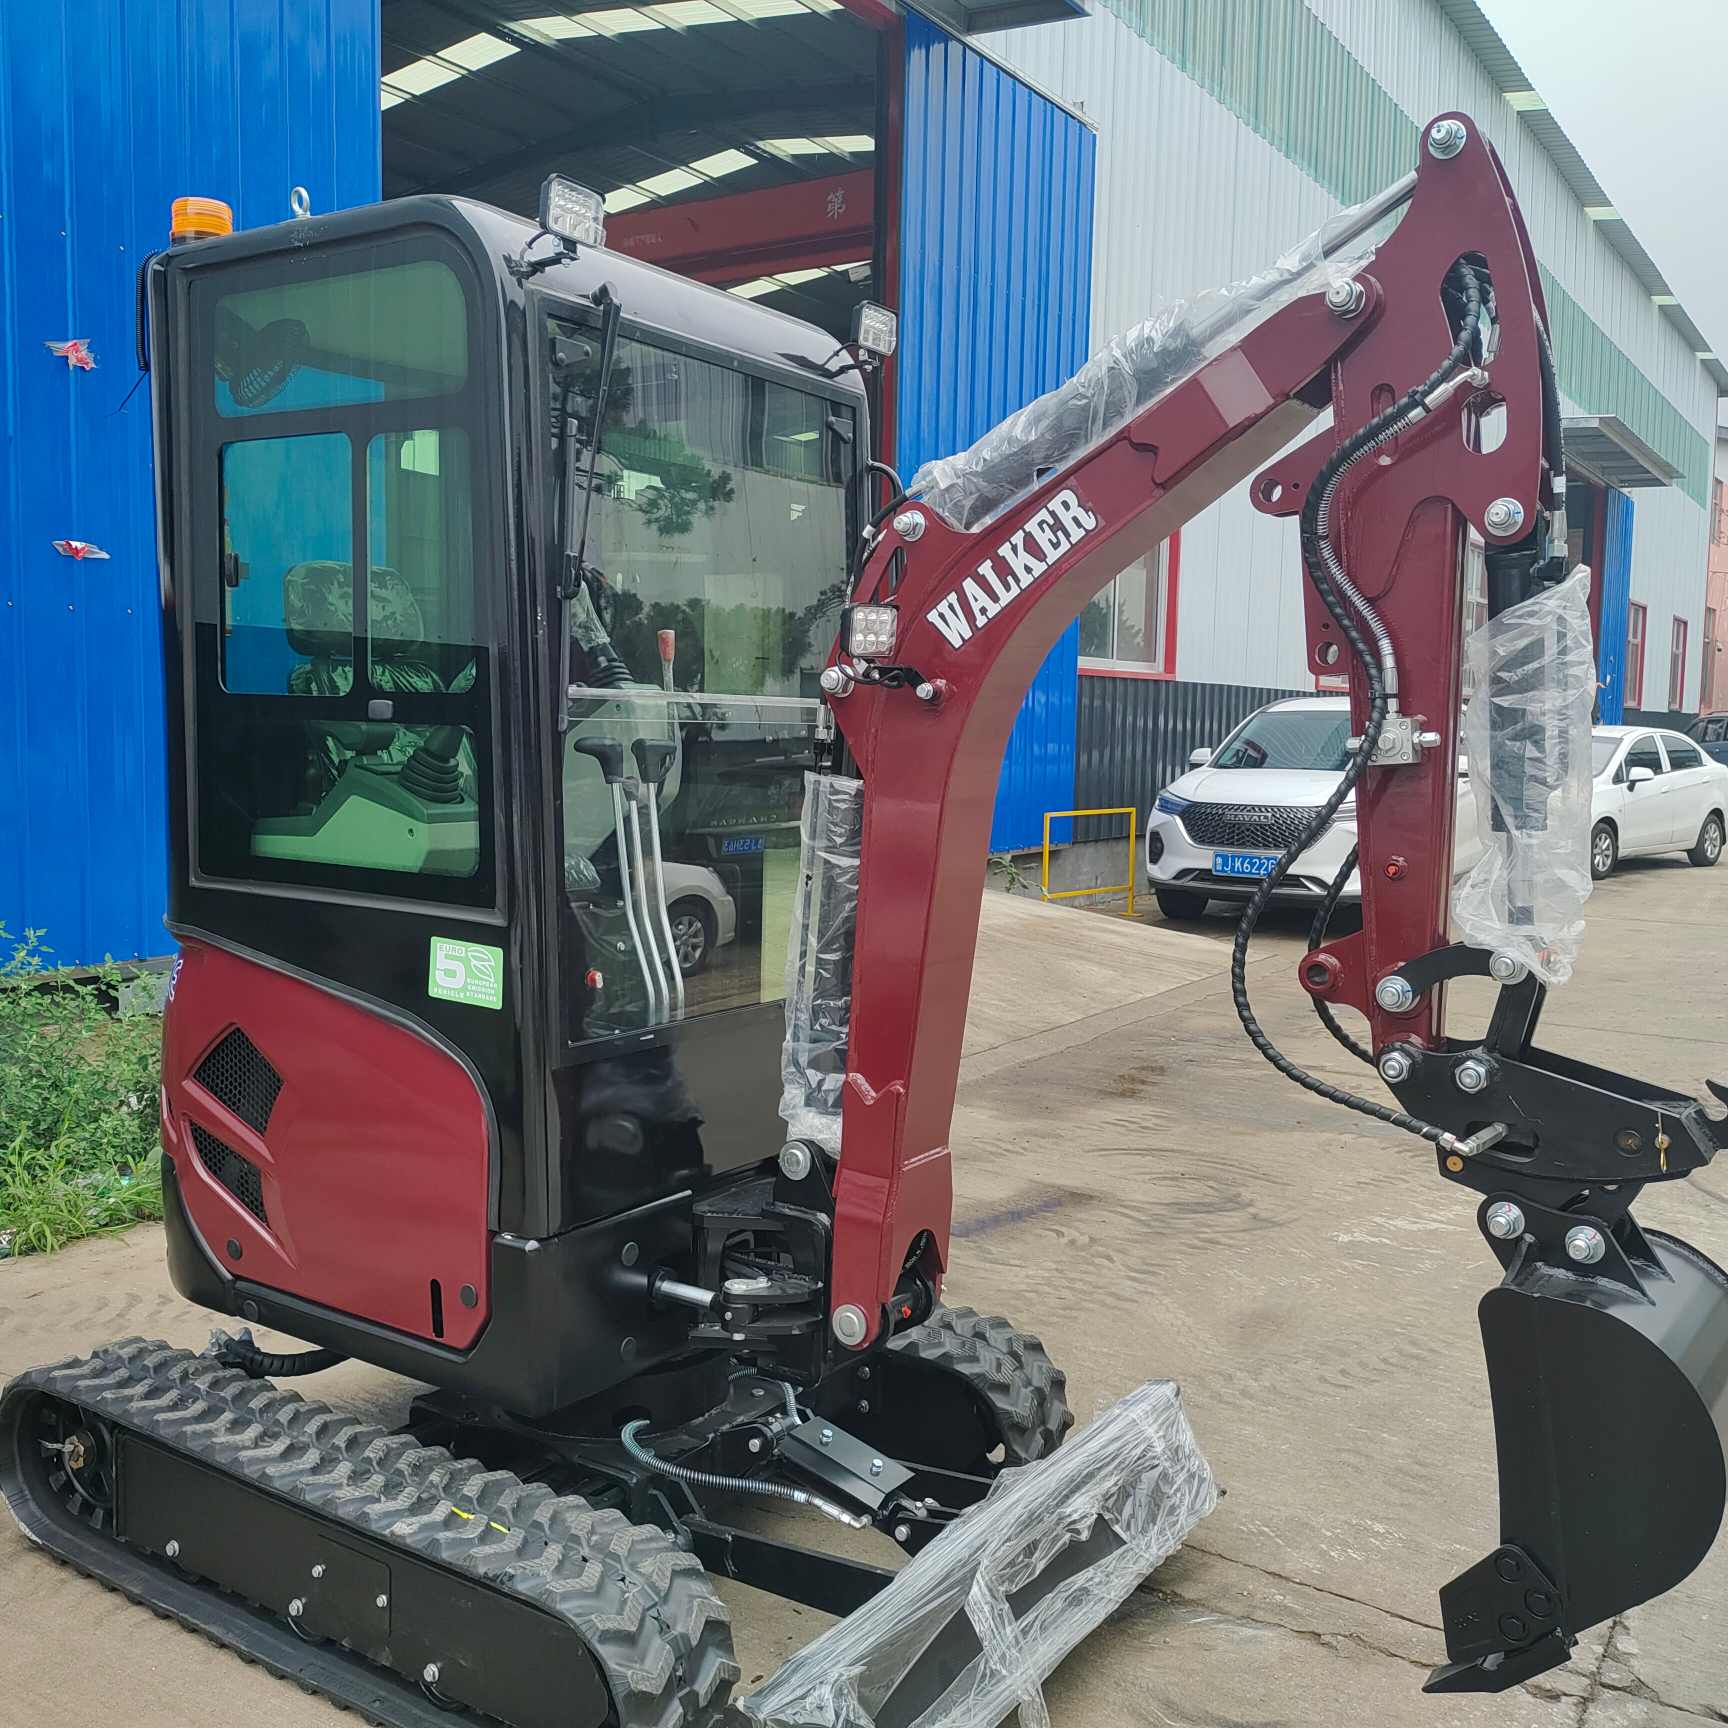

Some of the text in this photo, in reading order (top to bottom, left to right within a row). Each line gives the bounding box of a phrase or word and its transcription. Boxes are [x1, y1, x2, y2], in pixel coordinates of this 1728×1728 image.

[825, 187, 847, 221] 第
[926, 489, 1098, 649] WALKER
[1226, 813, 1270, 824] HAVAL
[435, 943, 465, 989] 5
[439, 944, 464, 955] EURO
